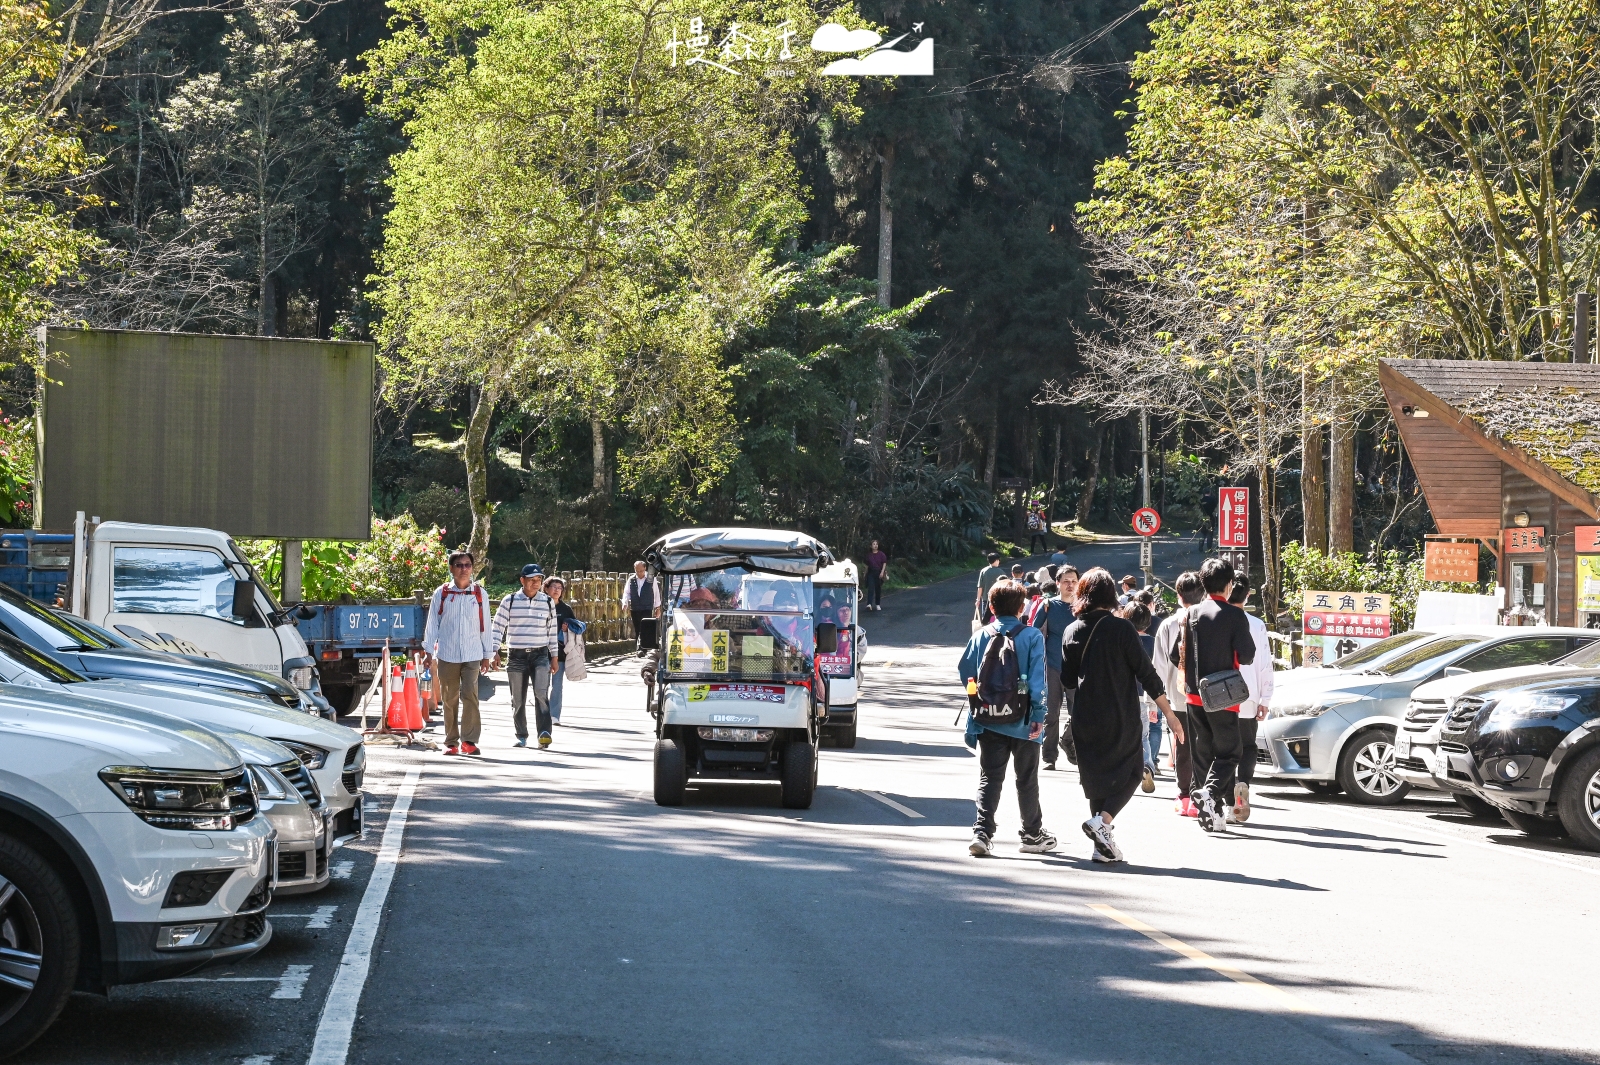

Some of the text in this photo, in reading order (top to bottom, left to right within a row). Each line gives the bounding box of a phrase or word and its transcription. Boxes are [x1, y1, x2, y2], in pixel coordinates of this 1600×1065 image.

[1139, 514, 1153, 529] 停
[1234, 490, 1246, 544] 停車方向
[1312, 594, 1383, 613] 五角亭
[1325, 614, 1384, 626] 臺大實驗林
[1325, 624, 1384, 637] 溪頭教育中心
[669, 631, 683, 671] 大學樓
[713, 631, 727, 671] 大學池
[693, 691, 703, 700] 5
[979, 703, 1013, 717] FILA
